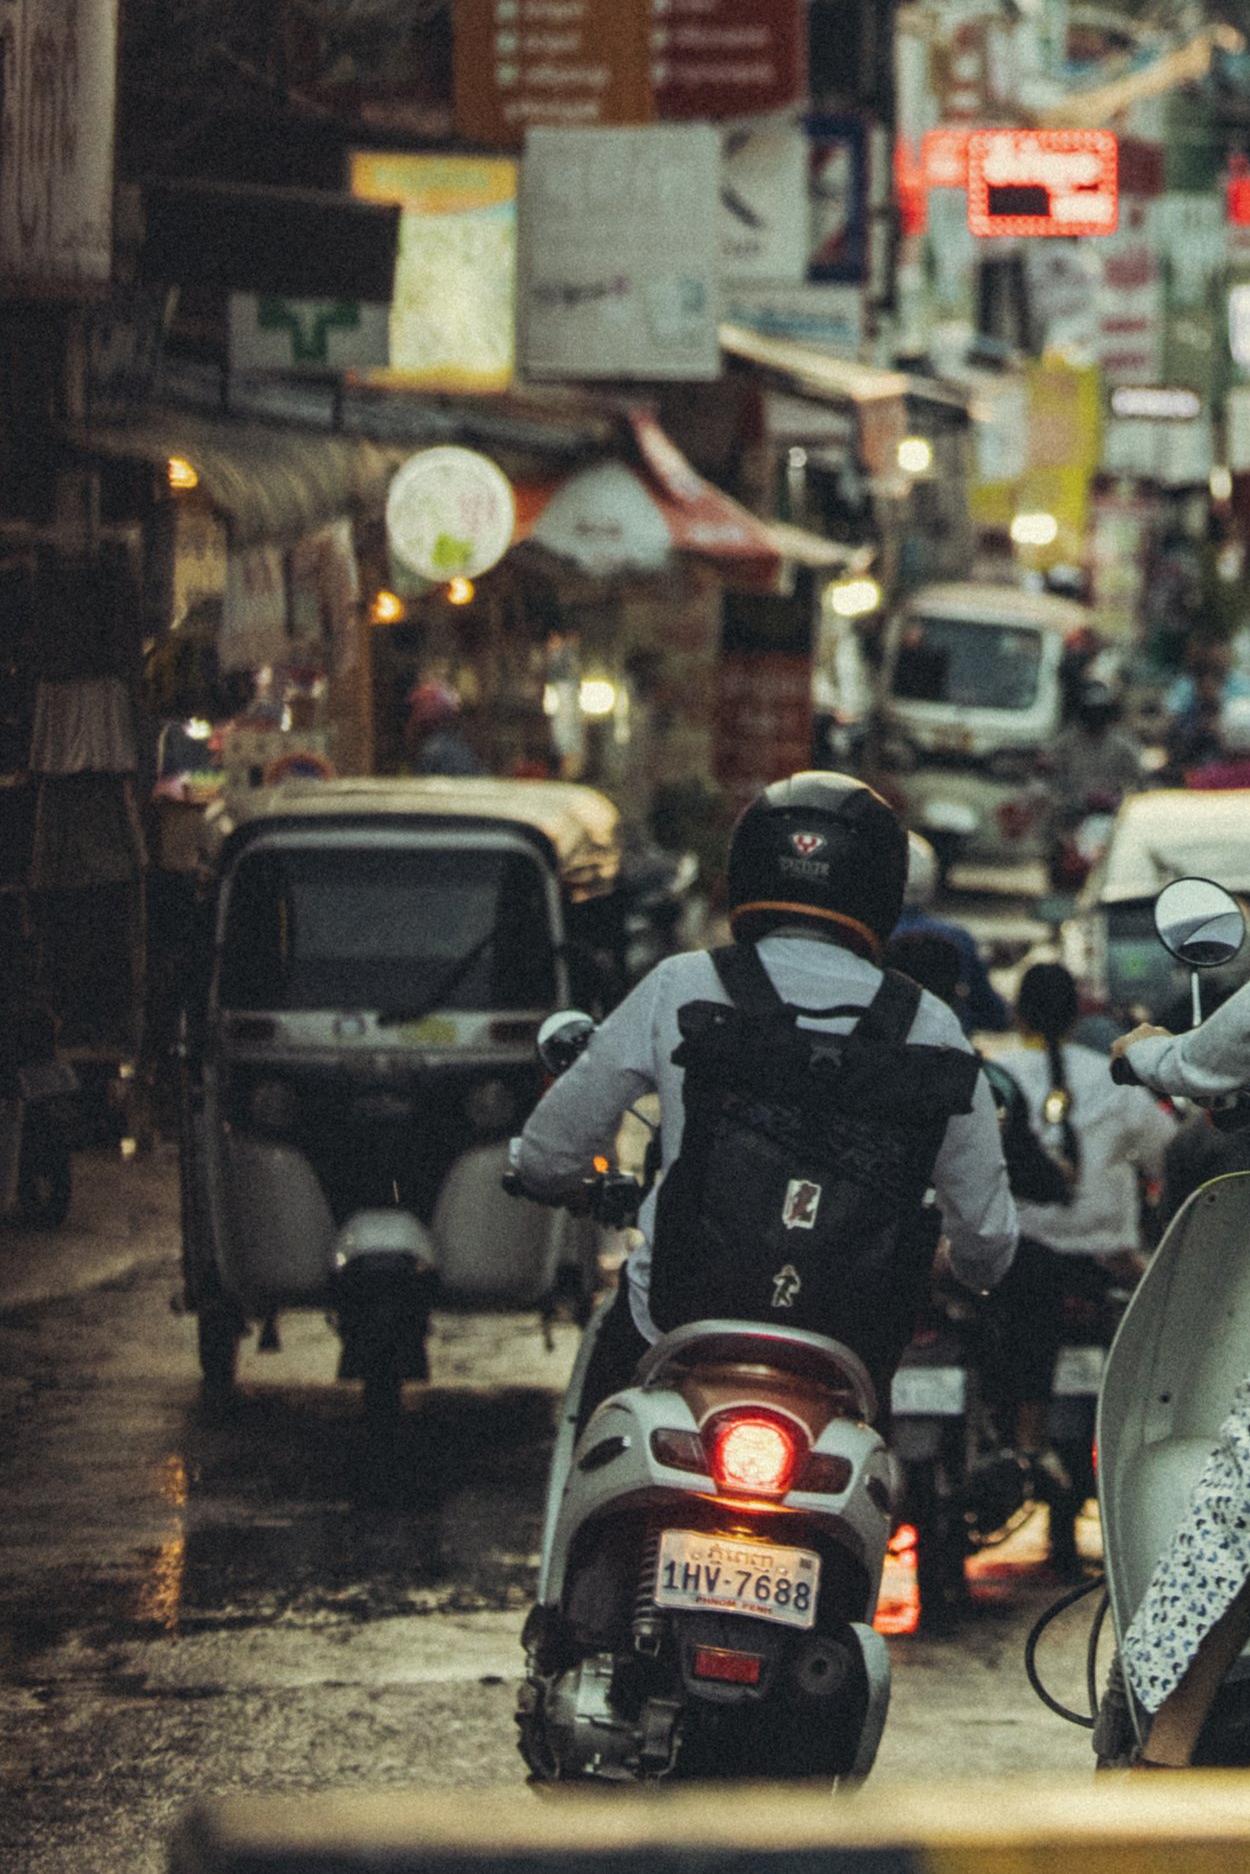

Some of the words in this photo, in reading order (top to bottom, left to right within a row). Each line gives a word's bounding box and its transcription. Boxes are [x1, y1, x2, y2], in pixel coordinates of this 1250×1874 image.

[662, 1560, 811, 1612] 1HV-7688
[695, 1596, 737, 1608] PHNOM
[742, 1603, 773, 1615] PENH
